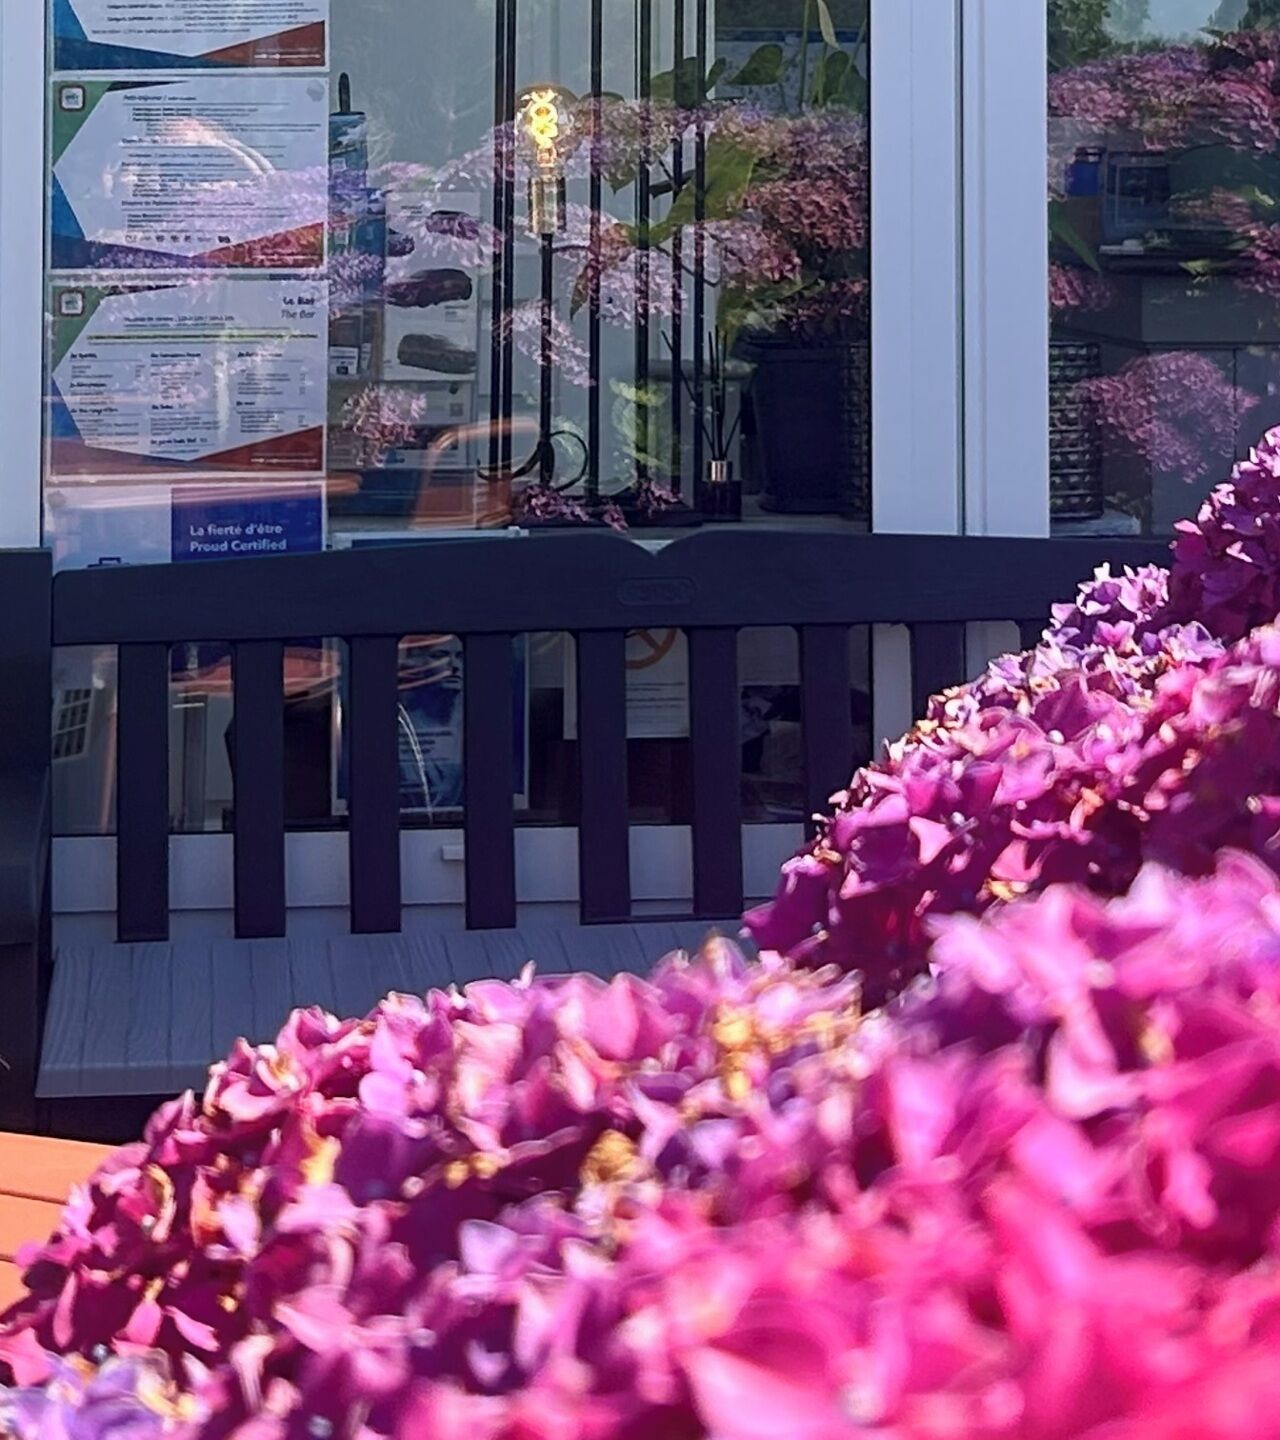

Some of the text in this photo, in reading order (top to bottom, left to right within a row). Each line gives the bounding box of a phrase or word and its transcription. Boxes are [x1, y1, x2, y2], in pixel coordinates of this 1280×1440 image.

[281, 309, 317, 320] The Bar
[190, 522, 283, 537] La fierté d'être
[189, 538, 287, 553] Proud Certified
